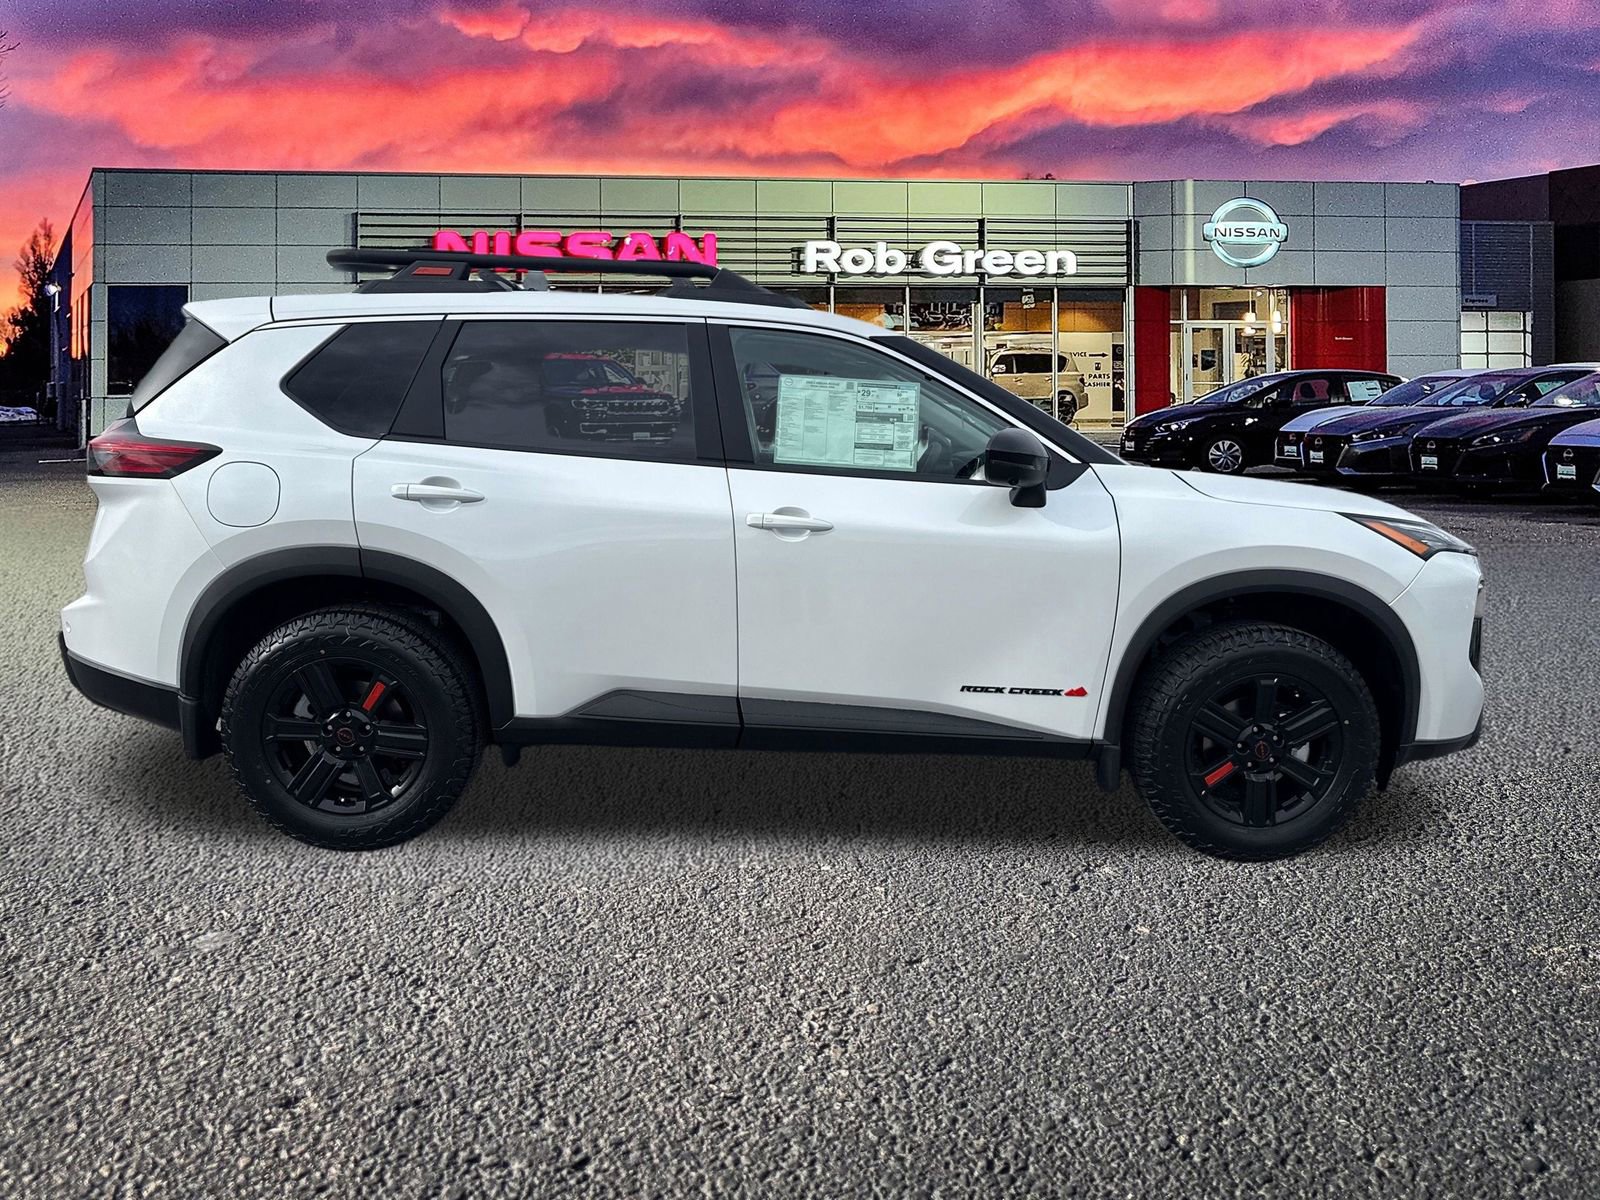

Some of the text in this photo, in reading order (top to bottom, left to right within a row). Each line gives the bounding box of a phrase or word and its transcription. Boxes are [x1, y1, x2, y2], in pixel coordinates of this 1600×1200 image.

[1213, 227, 1280, 238] NISSAN
[432, 230, 719, 268] NISSAN
[804, 240, 1078, 275] Rob Green
[960, 685, 1065, 696] ROCK CREEK
